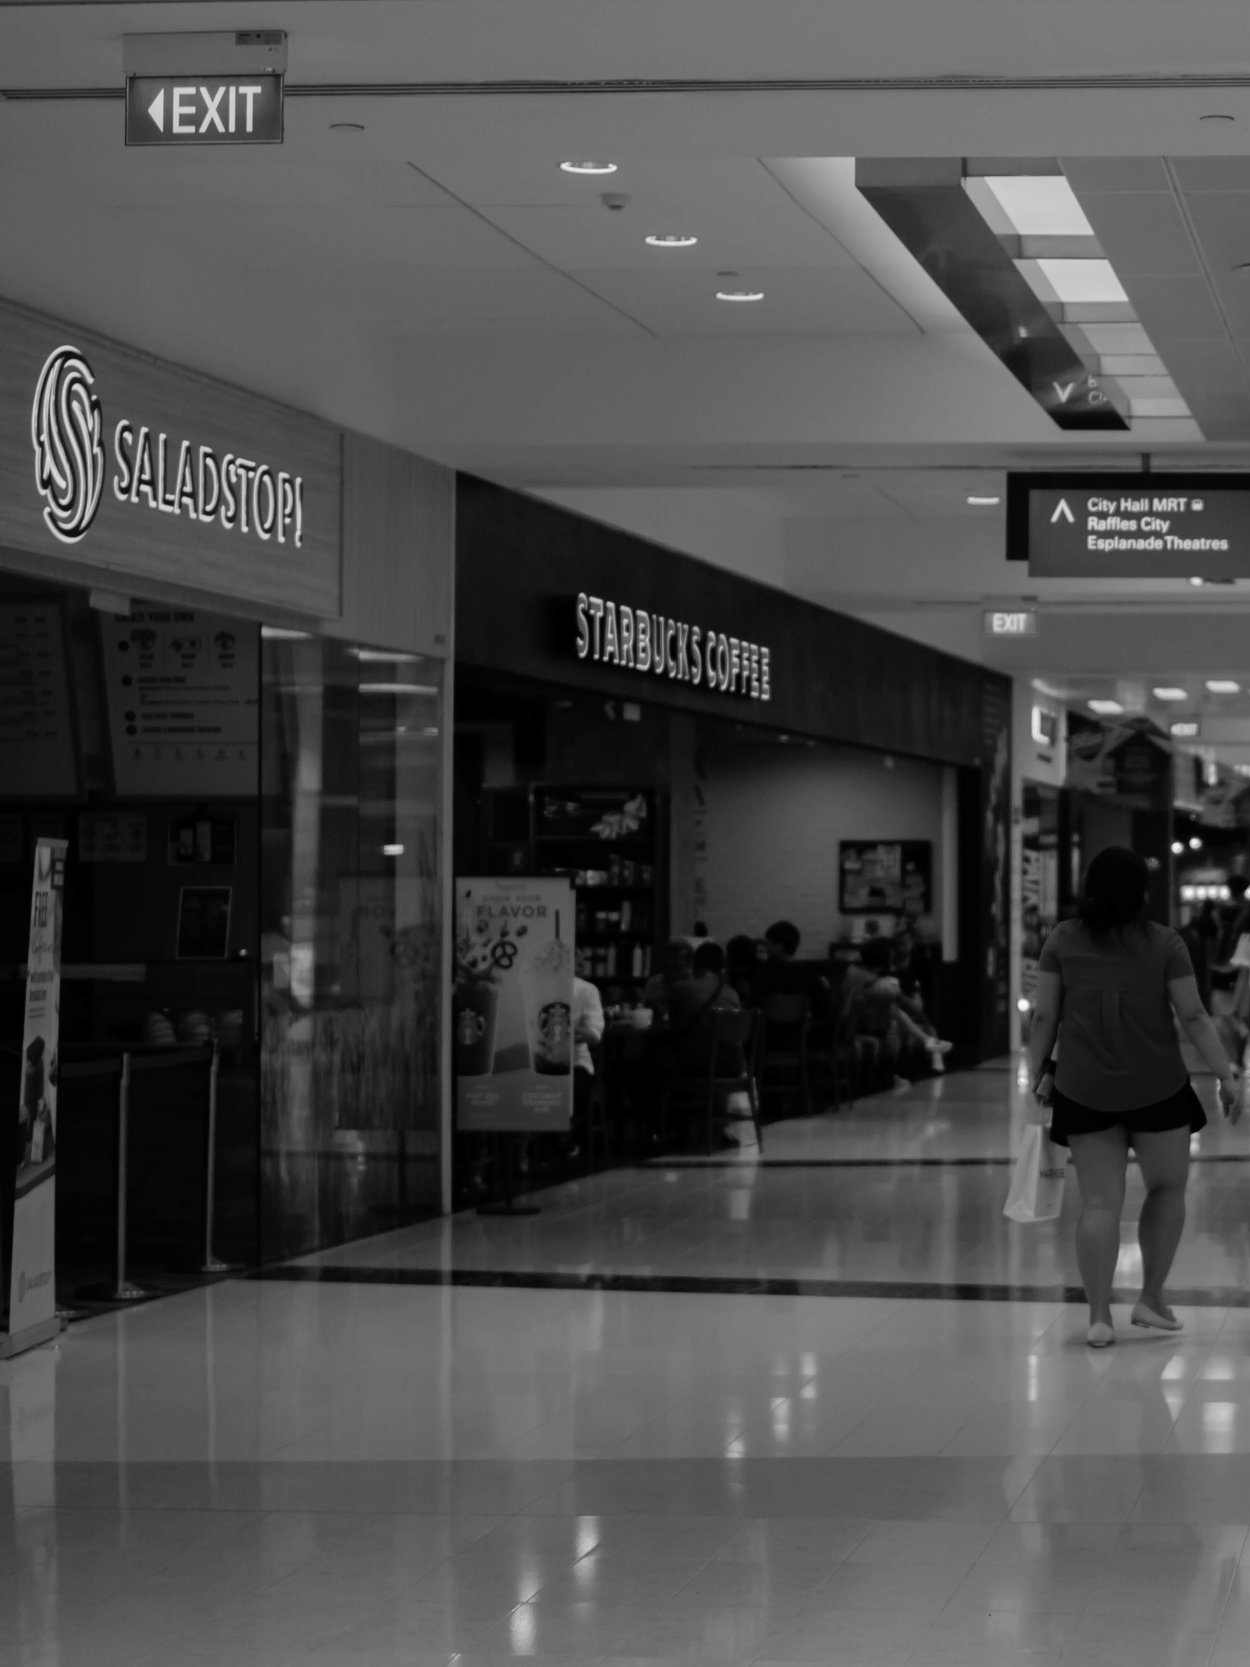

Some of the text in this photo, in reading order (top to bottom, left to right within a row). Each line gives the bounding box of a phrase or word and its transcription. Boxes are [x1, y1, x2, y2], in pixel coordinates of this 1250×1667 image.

[173, 86, 262, 134] EXIT
[113, 419, 304, 548] SALADSTOP!
[1086, 498, 1187, 514] City Hall MRT
[1086, 516, 1170, 534] Raffles City
[1086, 536, 1229, 552] Esplanade Theatres
[993, 613, 1027, 633] EXIT
[575, 592, 771, 701] STARBUCKS COFFEE
[476, 904, 547, 918] FLAVOR
